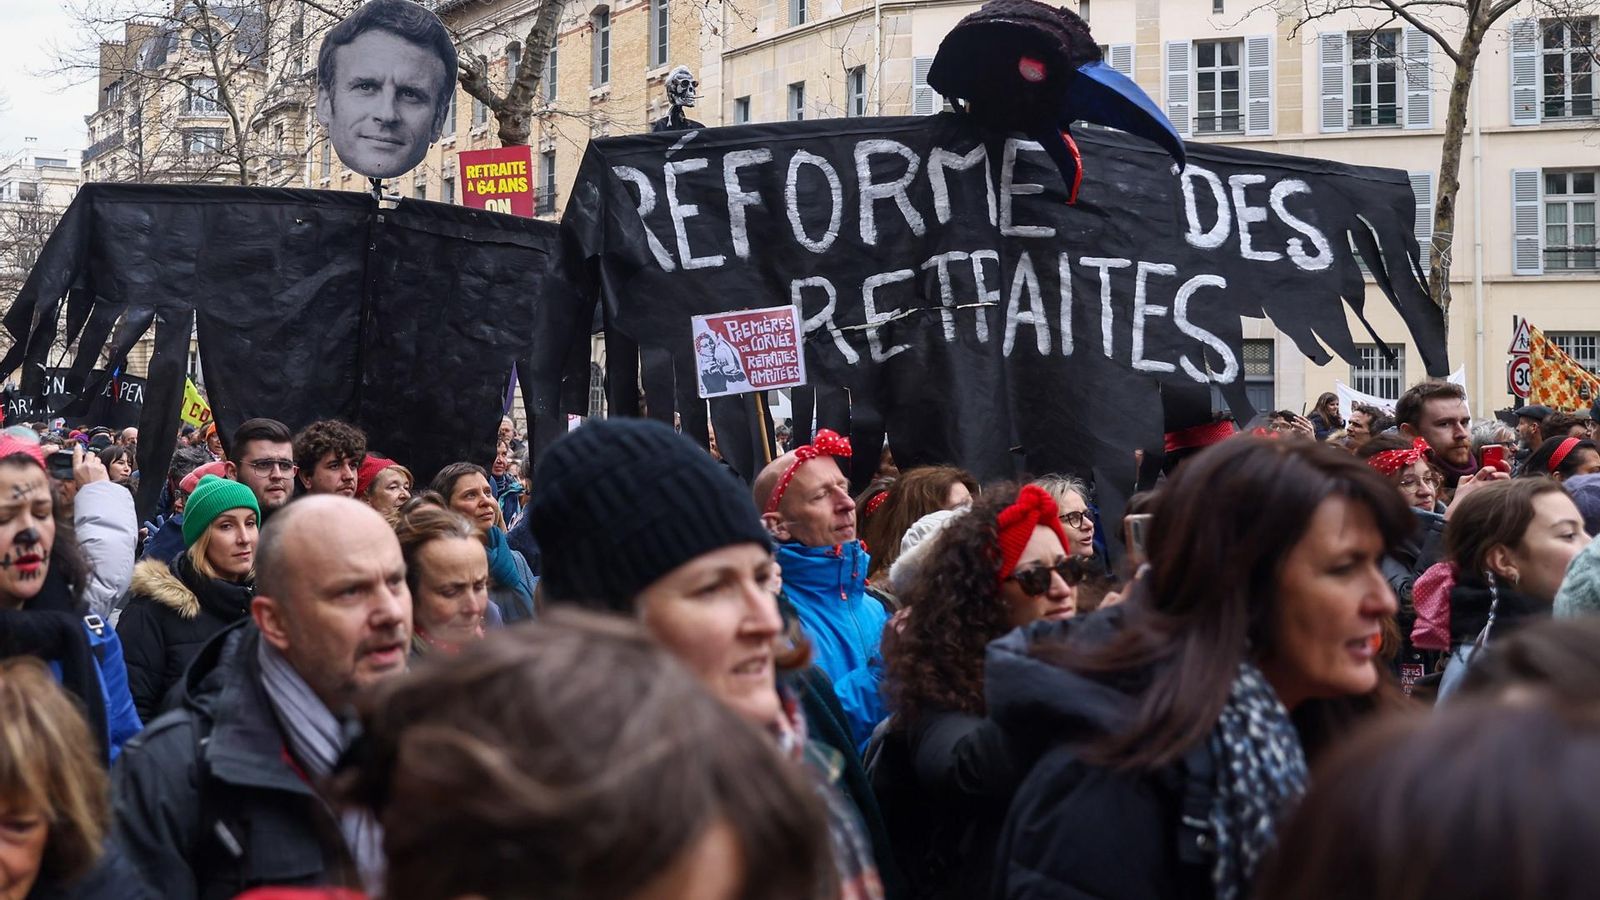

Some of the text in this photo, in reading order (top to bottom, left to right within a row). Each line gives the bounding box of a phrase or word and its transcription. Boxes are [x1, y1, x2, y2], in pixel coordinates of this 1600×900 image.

[466, 161, 527, 179] RETRAITE
[468, 177, 528, 195] À 64 ANS
[485, 198, 512, 214] ON
[612, 131, 1334, 272] RÉFORME DES
[751, 332, 794, 352] CORVÉE
[751, 366, 799, 384] AMPUTÉES
